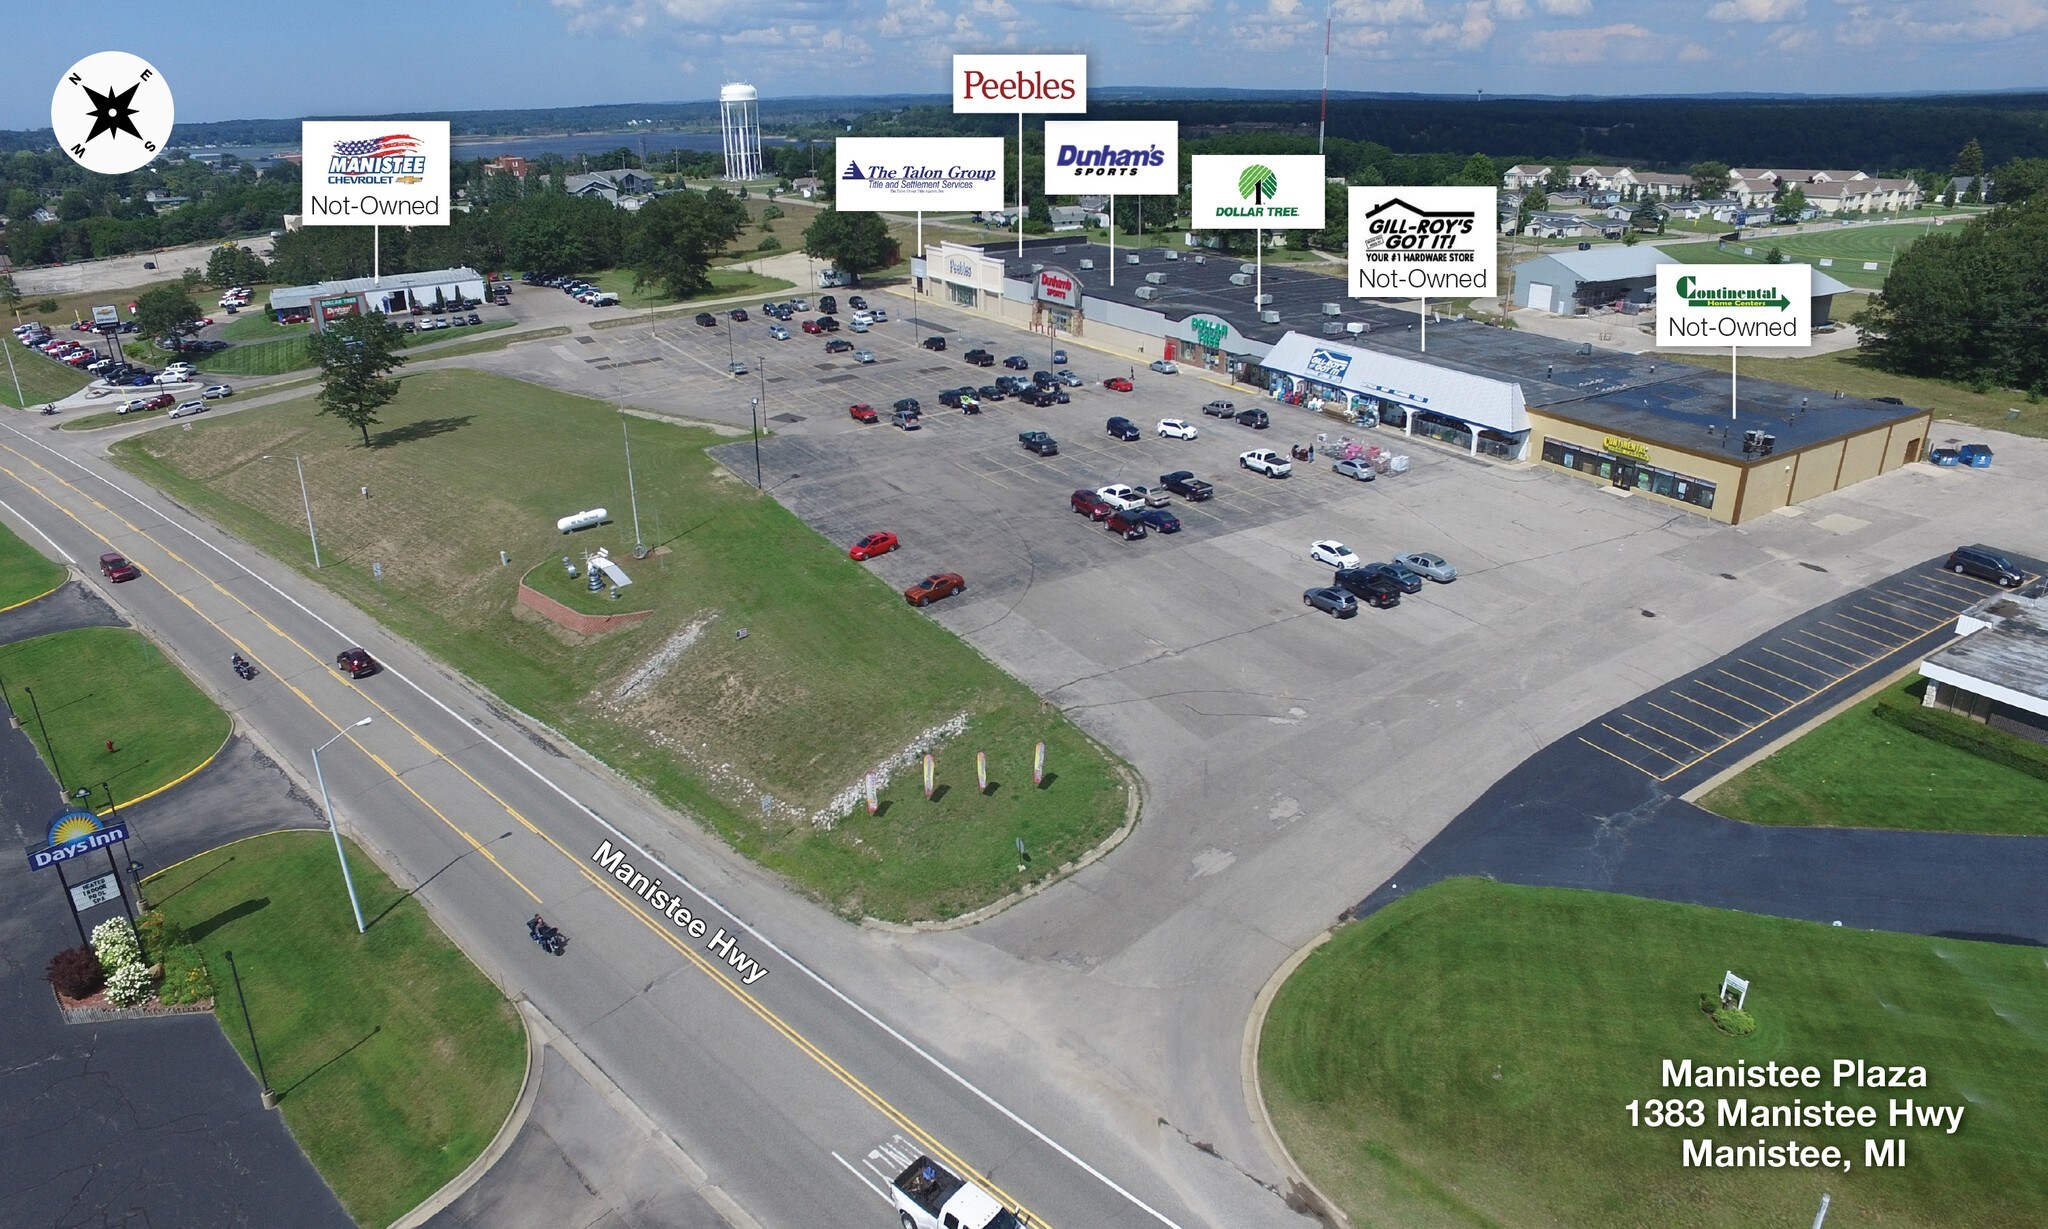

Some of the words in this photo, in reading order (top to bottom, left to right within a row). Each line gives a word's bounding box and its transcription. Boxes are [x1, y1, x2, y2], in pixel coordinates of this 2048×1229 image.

[1041, 273, 1072, 291] Dunham's
[1046, 287, 1066, 300] SPORTS
[321, 299, 342, 307] DOLLAR
[1191, 316, 1229, 337] DOLLAR
[1198, 331, 1221, 349] TREE
[1314, 364, 1330, 373] GOT
[35, 841, 89, 867] Days
[89, 828, 123, 848] Inn
[82, 883, 107, 896] INDOOR
[88, 890, 106, 900] POOL
[92, 896, 106, 904] SPA
